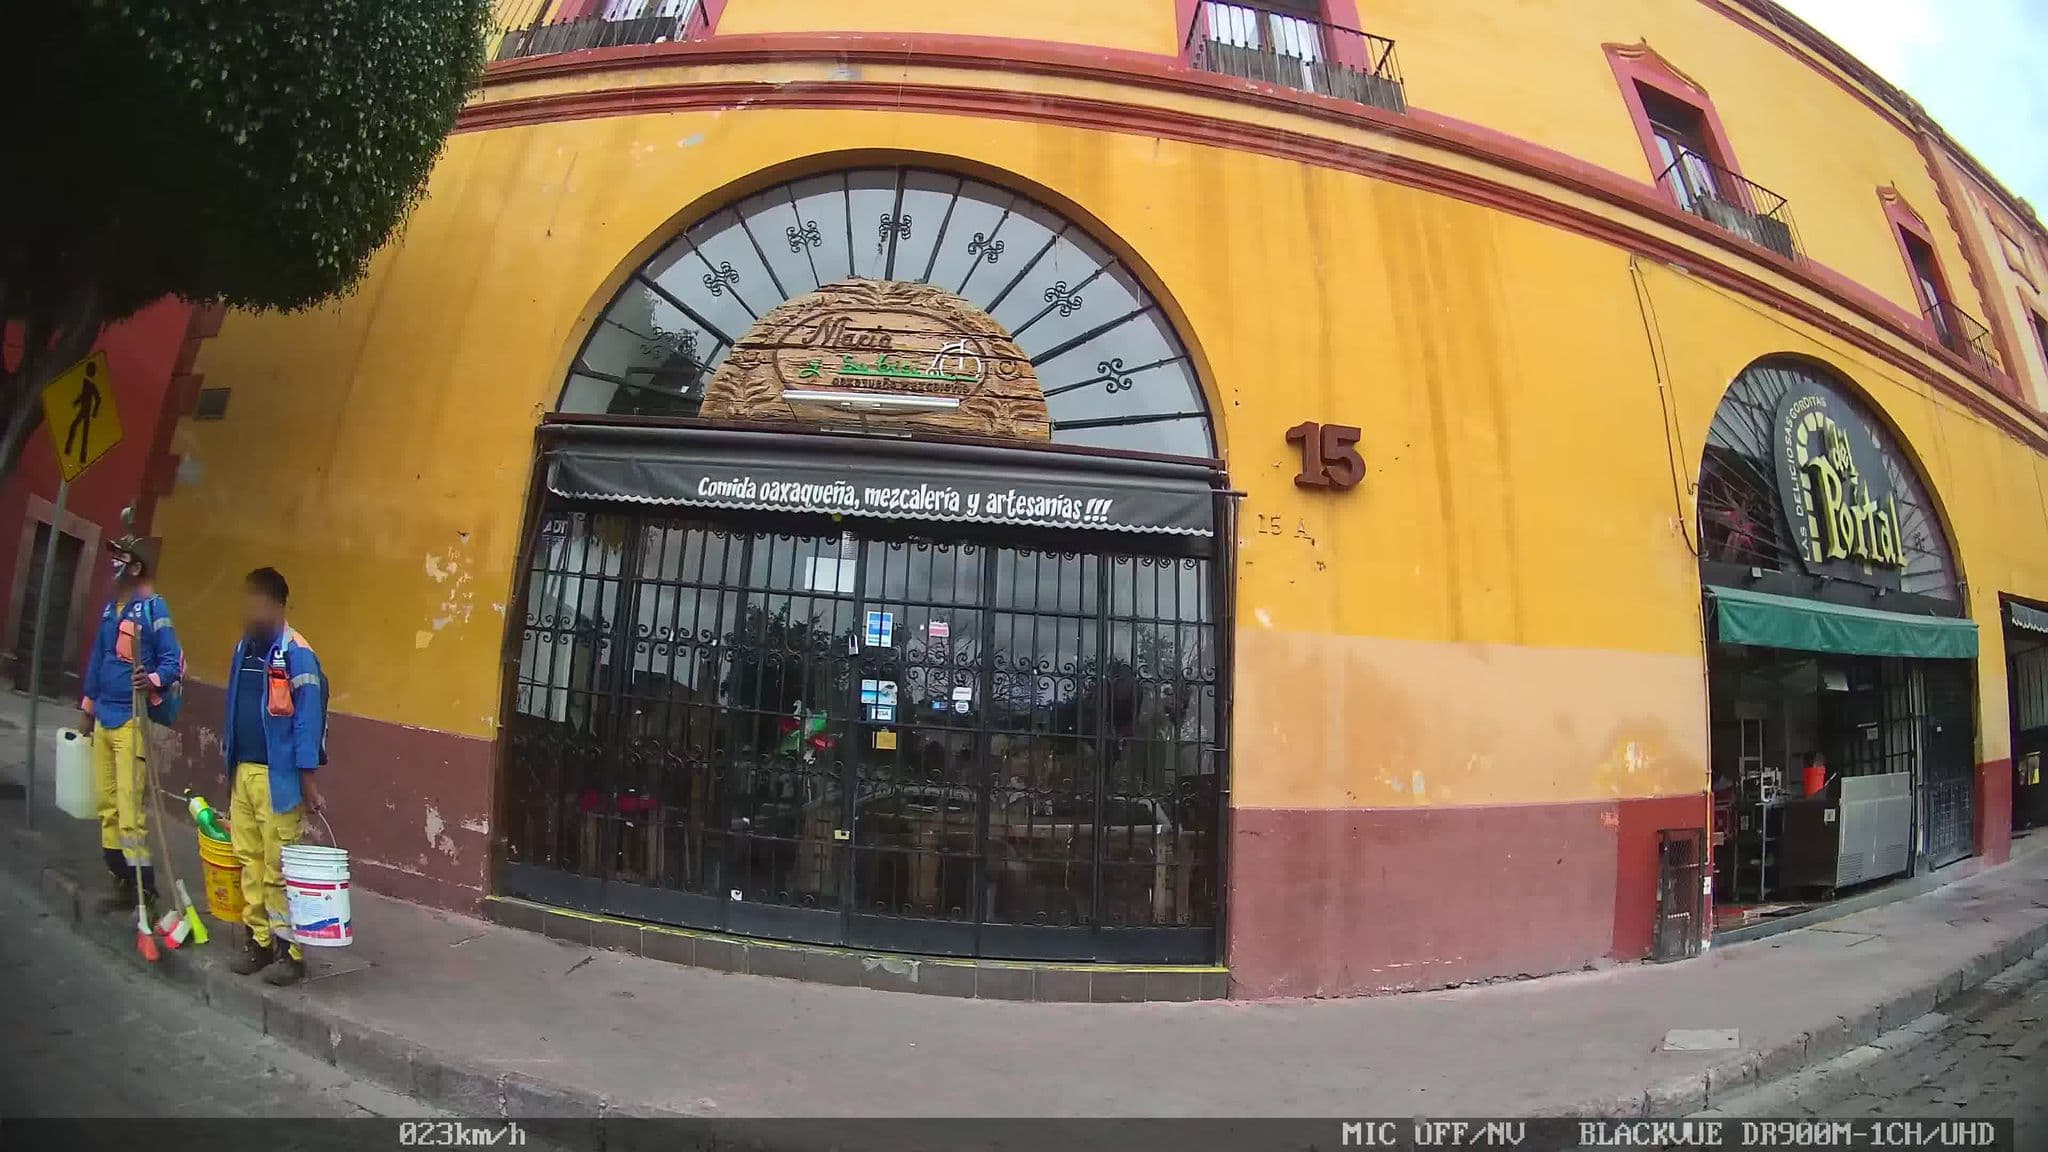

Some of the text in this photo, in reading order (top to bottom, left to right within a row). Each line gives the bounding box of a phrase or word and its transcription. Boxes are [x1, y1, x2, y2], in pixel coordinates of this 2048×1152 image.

[1790, 395, 1827, 419] GORDITAS
[1286, 421, 1366, 490] 15
[1829, 425, 1858, 485] del
[698, 477, 756, 499] Comida
[760, 480, 860, 510] oaxaqueña,
[864, 484, 960, 512] mezcalería
[967, 493, 980, 516] y
[986, 489, 1082, 520] artesanías
[1808, 455, 1908, 567] Portal
[1258, 514, 1282, 536] 15
[1801, 526, 1811, 561] LAS
